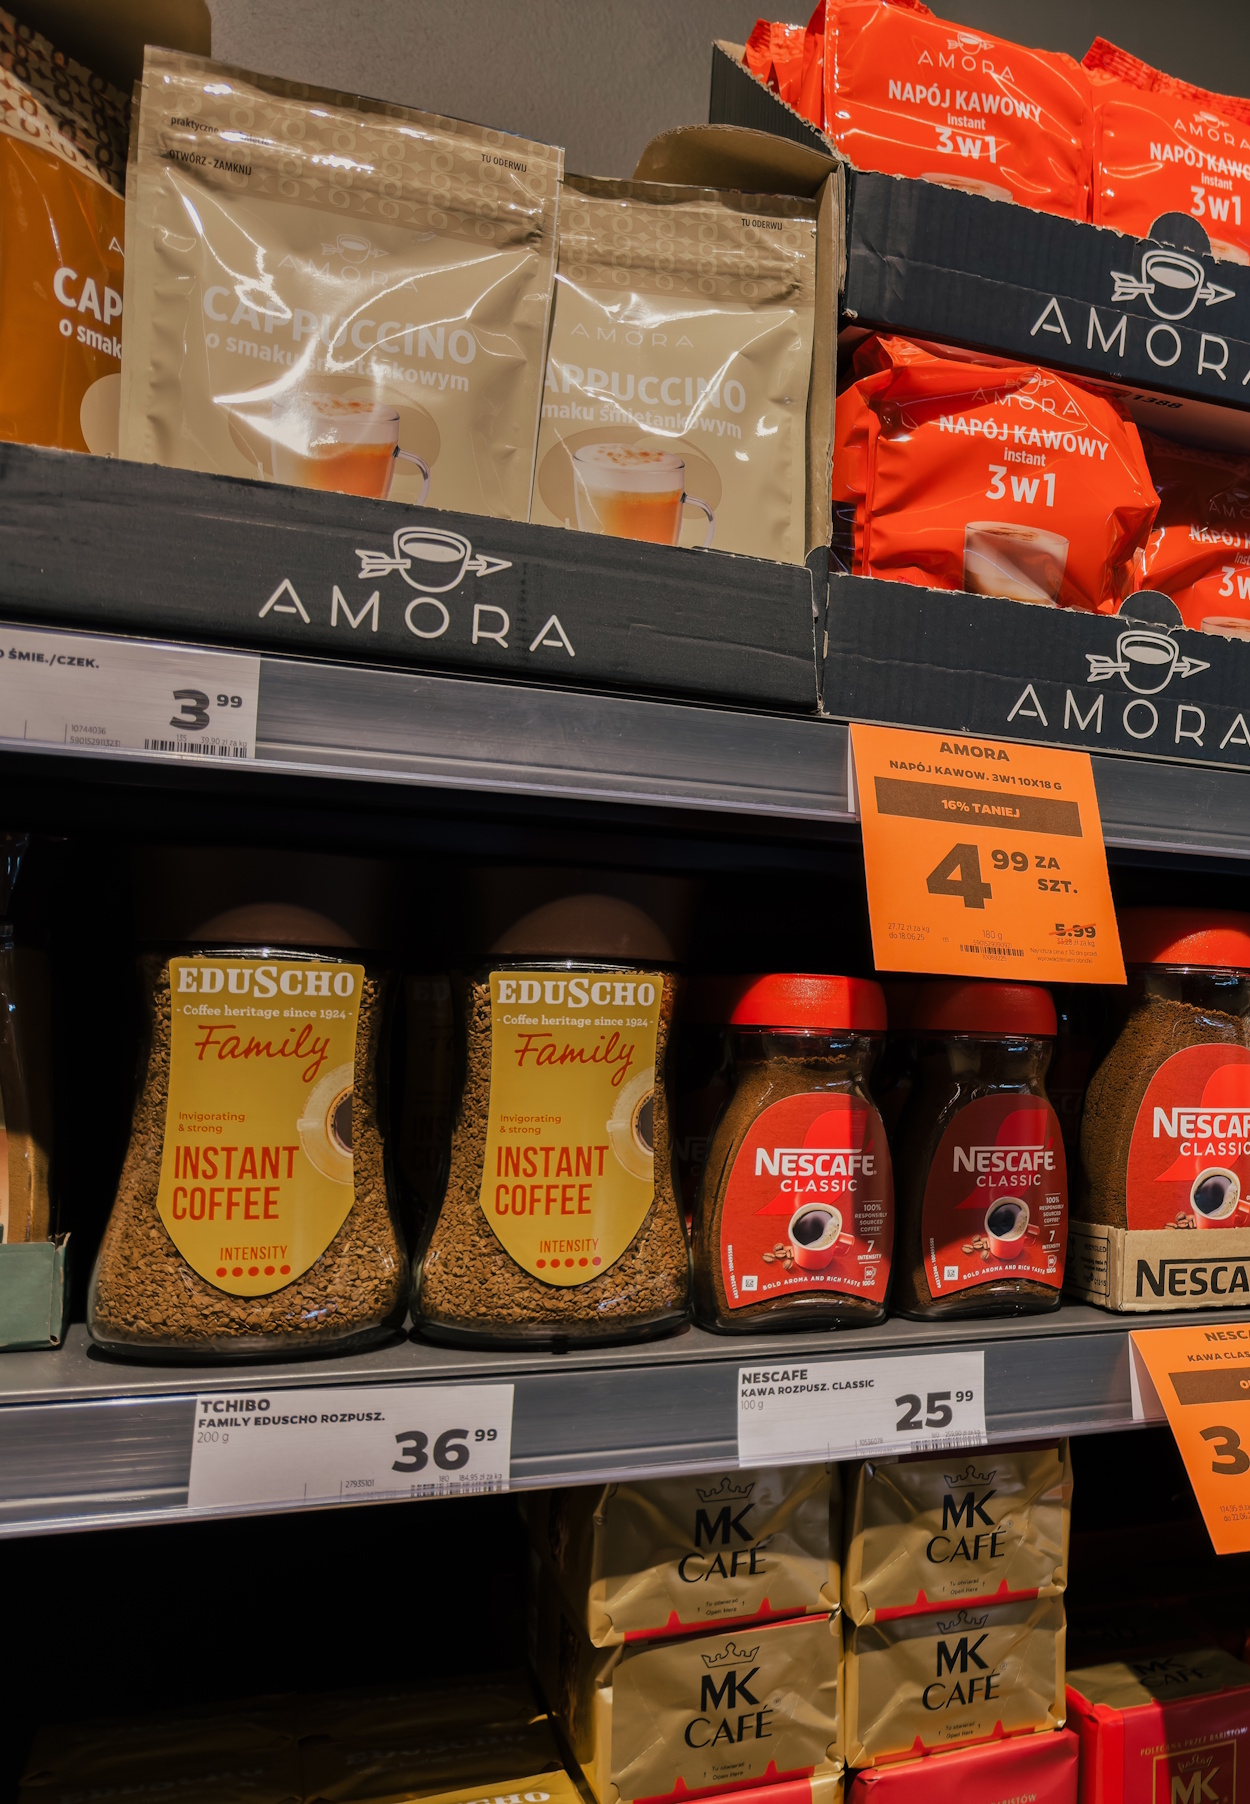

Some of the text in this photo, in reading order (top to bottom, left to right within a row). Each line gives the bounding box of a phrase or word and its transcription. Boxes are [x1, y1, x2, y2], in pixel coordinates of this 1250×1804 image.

[917, 50, 1014, 82] AMORA
[888, 78, 1042, 123] NAPÓJ KAWOWY
[947, 112, 987, 131] instant
[935, 126, 998, 164] 3w1
[1150, 140, 1204, 167] NAPÓJ
[169, 149, 252, 176] OTWÓRZ ZAMKNIJ
[481, 153, 528, 173] TU ODERWIJ
[1201, 172, 1233, 192] instant
[1190, 186, 1243, 226] 3w1
[741, 218, 783, 231] TU ODERWIJ
[203, 285, 476, 365] CAPPUCCINO
[938, 413, 1109, 461] NAPÓJ KAWOWY
[1003, 446, 1047, 467] instant
[984, 463, 1056, 508] 3w1
[257, 577, 576, 658] AMORA
[8, 648, 100, 670] ŚMIE./CZEK.
[939, 741, 1010, 762] AMORA
[941, 799, 1020, 819] 16% TANIEJ
[926, 842, 1061, 910] 4 99 ZA
[1037, 878, 1079, 895] SZT.
[177, 965, 355, 998] EDUSCHO
[497, 978, 656, 1009] EDUSCHO
[183, 1004, 347, 1021] Coffee heritage since 1924
[194, 1023, 331, 1083] Family
[178, 1111, 246, 1124] Invigorating
[173, 1145, 300, 1180] INSTANT
[496, 1145, 609, 1178] INSTANT
[780, 1179, 858, 1193] CLASSIC
[976, 1174, 1042, 1187] CLASSIC
[172, 1186, 280, 1221] COFFEE
[494, 1183, 593, 1217] COFFEE
[219, 1245, 288, 1262] INTENSITY
[539, 1238, 600, 1253] INTENSITY
[763, 1281, 778, 1291] BOLD
[779, 1275, 809, 1286] AROMA
[826, 1275, 842, 1284] RICH
[843, 1278, 861, 1288] TASTE
[1187, 1352, 1222, 1363] KAWA
[741, 1369, 808, 1384] NESCAFE
[741, 1379, 875, 1397] KAWA ROZPUSZ. CLASSIC
[198, 1411, 386, 1428] FAMILY EDUSCHO ROZPUSZ.
[200, 1398, 271, 1414] TCHIBO
[895, 1390, 974, 1432] 25 99
[197, 1431, 229, 1444] 200 g
[391, 1428, 498, 1474] 36 99
[941, 1489, 997, 1533] MK
[695, 1502, 756, 1548] MK
[935, 1633, 990, 1678] MK
[699, 1666, 761, 1712] MK
